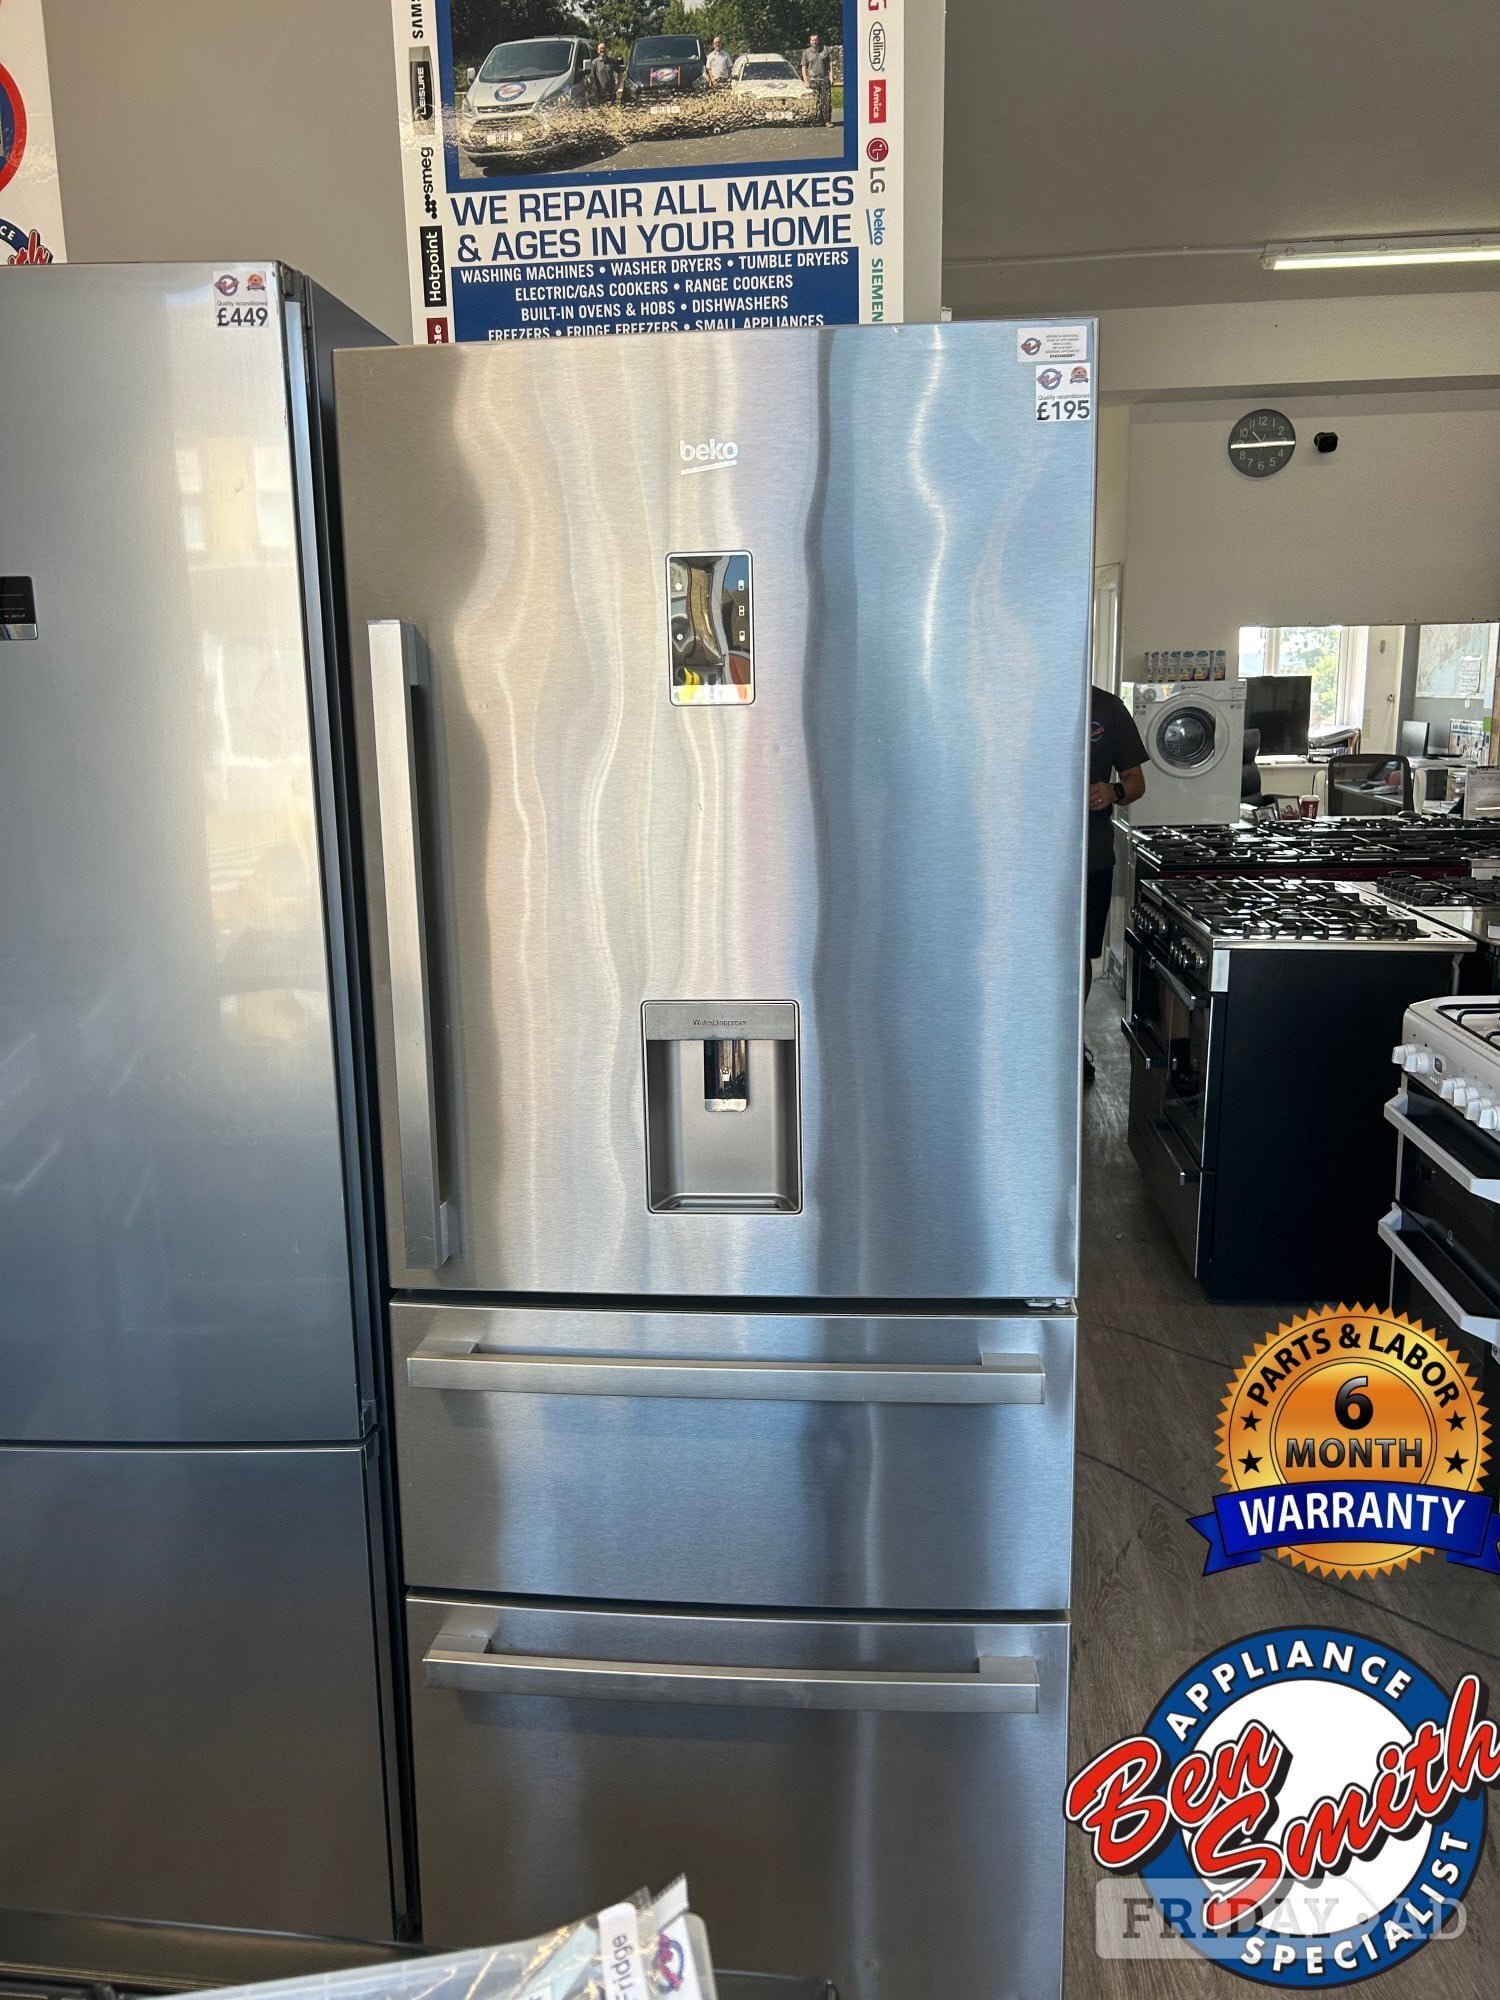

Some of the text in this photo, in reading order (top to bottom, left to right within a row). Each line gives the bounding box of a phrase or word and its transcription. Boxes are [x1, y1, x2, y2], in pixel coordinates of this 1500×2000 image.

[411, 0, 424, 39] SAM
[417, 66, 427, 115] LEISURE
[873, 85, 882, 119] Amica
[420, 146, 434, 193] smeg
[870, 166, 885, 194] LG
[450, 175, 855, 227] WE REPAIR ALL MAKES
[457, 213, 852, 263] & AGES IN YOUR HOME
[873, 207, 885, 246] beko
[426, 231, 443, 302] Hotpoint
[460, 251, 849, 284] WASHING MACHINES WASHER DRYERS TUMBLE DRYERS
[515, 274, 794, 302] ELECTRIC/GAS COOKERS RANGE COOKERS
[216, 307, 269, 327] £449
[521, 295, 789, 322] BUILT-IN OVENS & HOBS DISHWASHERS
[566, 323, 611, 337] FRIDGE
[1036, 399, 1090, 421] £195
[1258, 415, 1268, 426] 12
[1239, 428, 1249, 438] 10
[1278, 426, 1285, 436] 2
[679, 438, 739, 462] beko
[1247, 458, 1254, 469] 7
[1268, 457, 1276, 467] 5
[1257, 460, 1265, 471] 6
